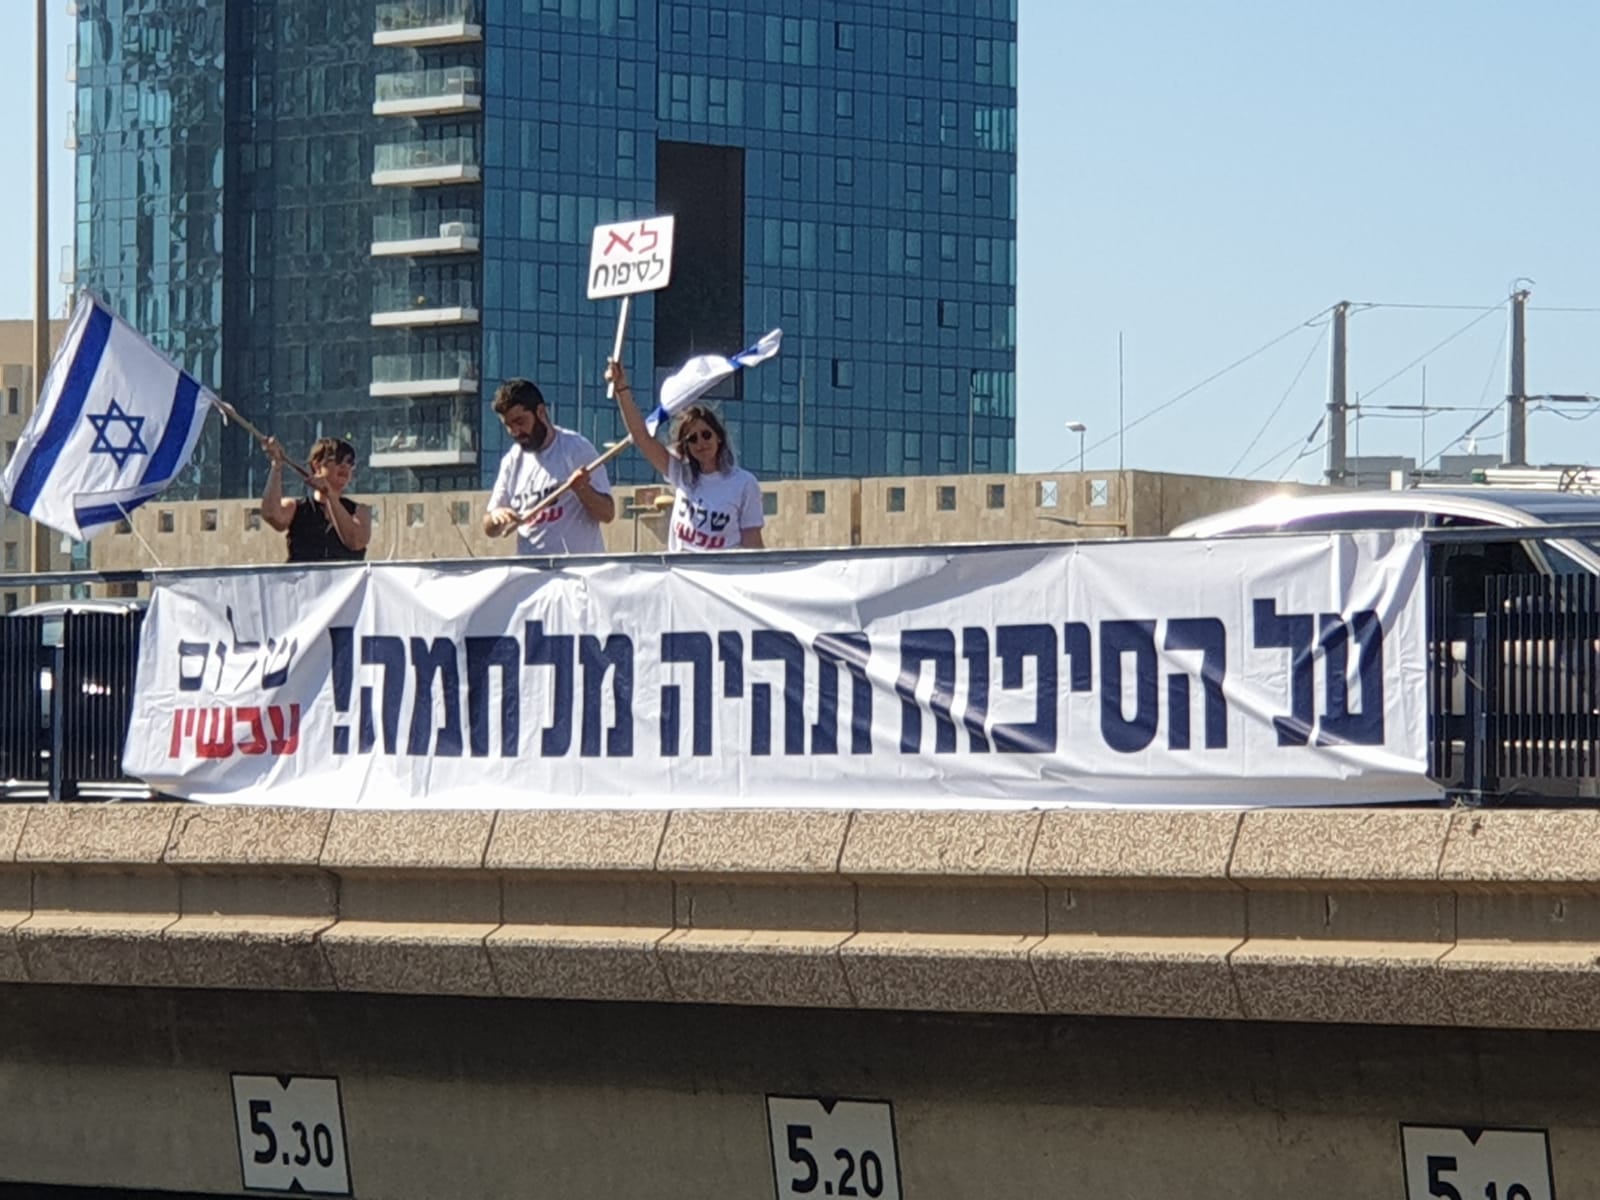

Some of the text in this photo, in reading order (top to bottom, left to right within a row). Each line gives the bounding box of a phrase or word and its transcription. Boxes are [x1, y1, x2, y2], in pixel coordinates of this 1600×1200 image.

[592, 252, 664, 290] לסיפוח
[603, 222, 658, 256] לא
[178, 605, 298, 692] שלום
[329, 598, 1384, 758] על הסיפוח תהיה מלחמה!
[168, 703, 300, 759] עכשיו
[249, 1100, 334, 1167] 5.30
[787, 1124, 884, 1198] 5.20
